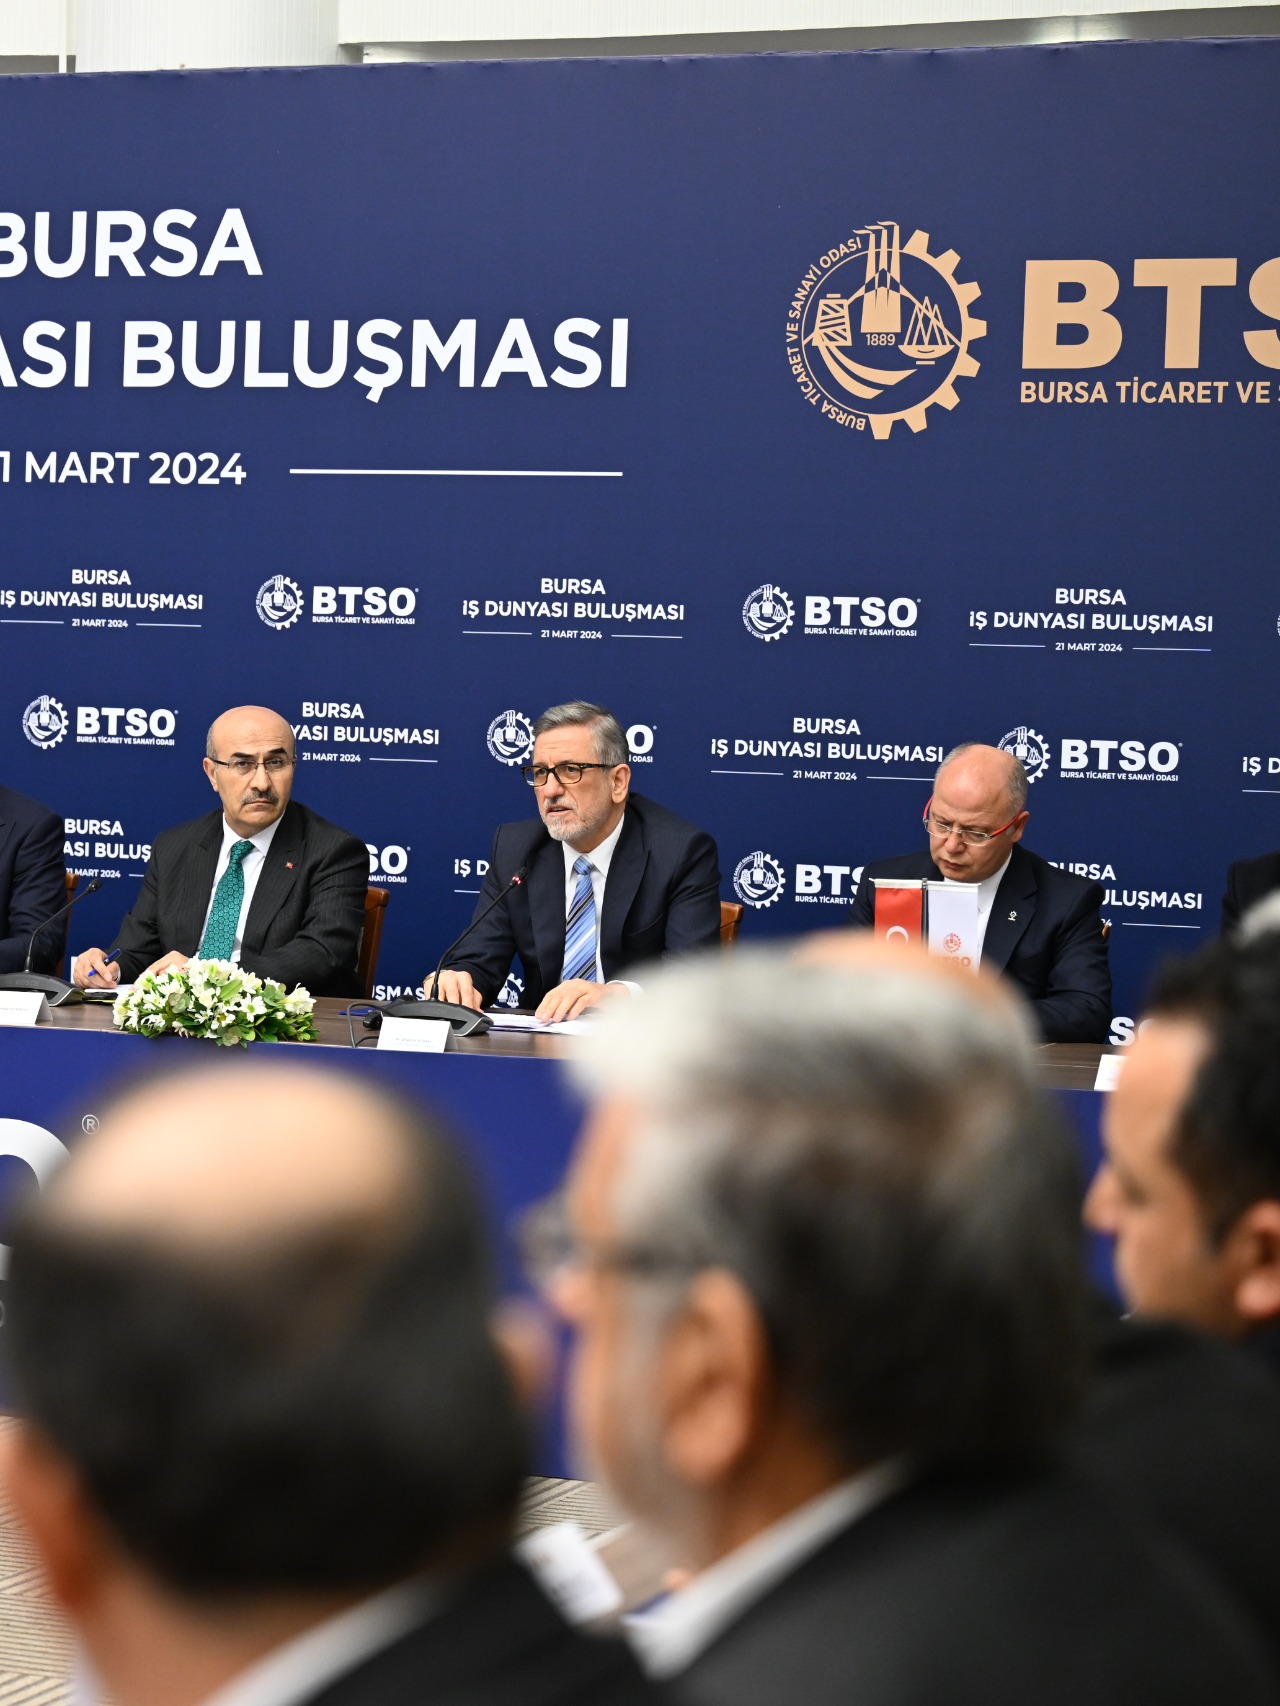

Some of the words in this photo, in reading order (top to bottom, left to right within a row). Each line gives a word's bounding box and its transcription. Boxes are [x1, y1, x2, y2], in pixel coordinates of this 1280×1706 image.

[820, 236, 862, 269] ODASI
[788, 264, 822, 319] SANAYİ
[1022, 257, 1280, 370] BT
[786, 322, 799, 343] VE
[865, 333, 896, 346] 1889
[123, 318, 628, 403] BULUŞMASI
[786, 346, 821, 405] TİCARET
[1021, 382, 1108, 403] BURSA
[1116, 377, 1228, 403] TİCARET
[1236, 382, 1270, 403] VE
[821, 400, 866, 430] BURSA
[26, 452, 139, 483] MART
[149, 452, 246, 484] 2024
[72, 569, 131, 585] BURSA
[541, 578, 605, 594] BURSA
[313, 586, 418, 617] BTSO
[1056, 588, 1126, 605] BURSA
[313, 615, 333, 623] BURSA
[335, 615, 360, 624] TİCARET
[362, 616, 370, 624] VE
[372, 616, 394, 625] SANAYİ
[396, 617, 415, 625] ODASI
[805, 597, 921, 628] BTSO
[72, 618, 80, 627] 21
[82, 618, 106, 627] MART
[108, 619, 128, 628] 2024
[805, 627, 827, 635] BURSA
[829, 626, 857, 636] TİCARET
[859, 628, 867, 636] VE
[869, 628, 894, 636] SANAYİ
[896, 629, 916, 637] ODASI
[541, 629, 549, 638] 21
[552, 629, 578, 639] MART
[580, 630, 602, 639] 2024
[1056, 642, 1064, 651] 21
[1068, 642, 1096, 651] MART
[1099, 643, 1122, 652] 2024
[303, 702, 364, 718] BURSA
[77, 707, 178, 737] BTSO
[794, 718, 860, 735] BURSA
[77, 735, 97, 743] BURSA
[98, 736, 123, 744] TİCARET
[124, 737, 131, 745] VE
[133, 737, 155, 746] SANAYİ
[156, 738, 174, 746] ODASI
[334, 726, 439, 746] BULUŞMASI
[303, 752, 310, 761] 21
[313, 752, 338, 762] MART
[340, 753, 361, 763] 2024
[1061, 739, 1182, 772] BTSO
[1243, 757, 1261, 776] İŞ
[793, 770, 801, 779] 21
[805, 770, 832, 780] MART
[834, 771, 857, 781] 2024
[1061, 770, 1084, 779] BURSA
[1086, 770, 1115, 780] TİCARET
[1117, 772, 1126, 780] VE
[1128, 772, 1154, 781] SANAYİ
[1156, 774, 1178, 782] ODASI
[65, 819, 123, 836] BURSA
[75, 868, 97, 878] MART
[100, 869, 121, 878] 2024
[796, 864, 864, 895] BT
[795, 895, 817, 903] BURSA
[819, 895, 847, 905] TİCARET
[1102, 890, 1202, 909] ULUŞMASI
